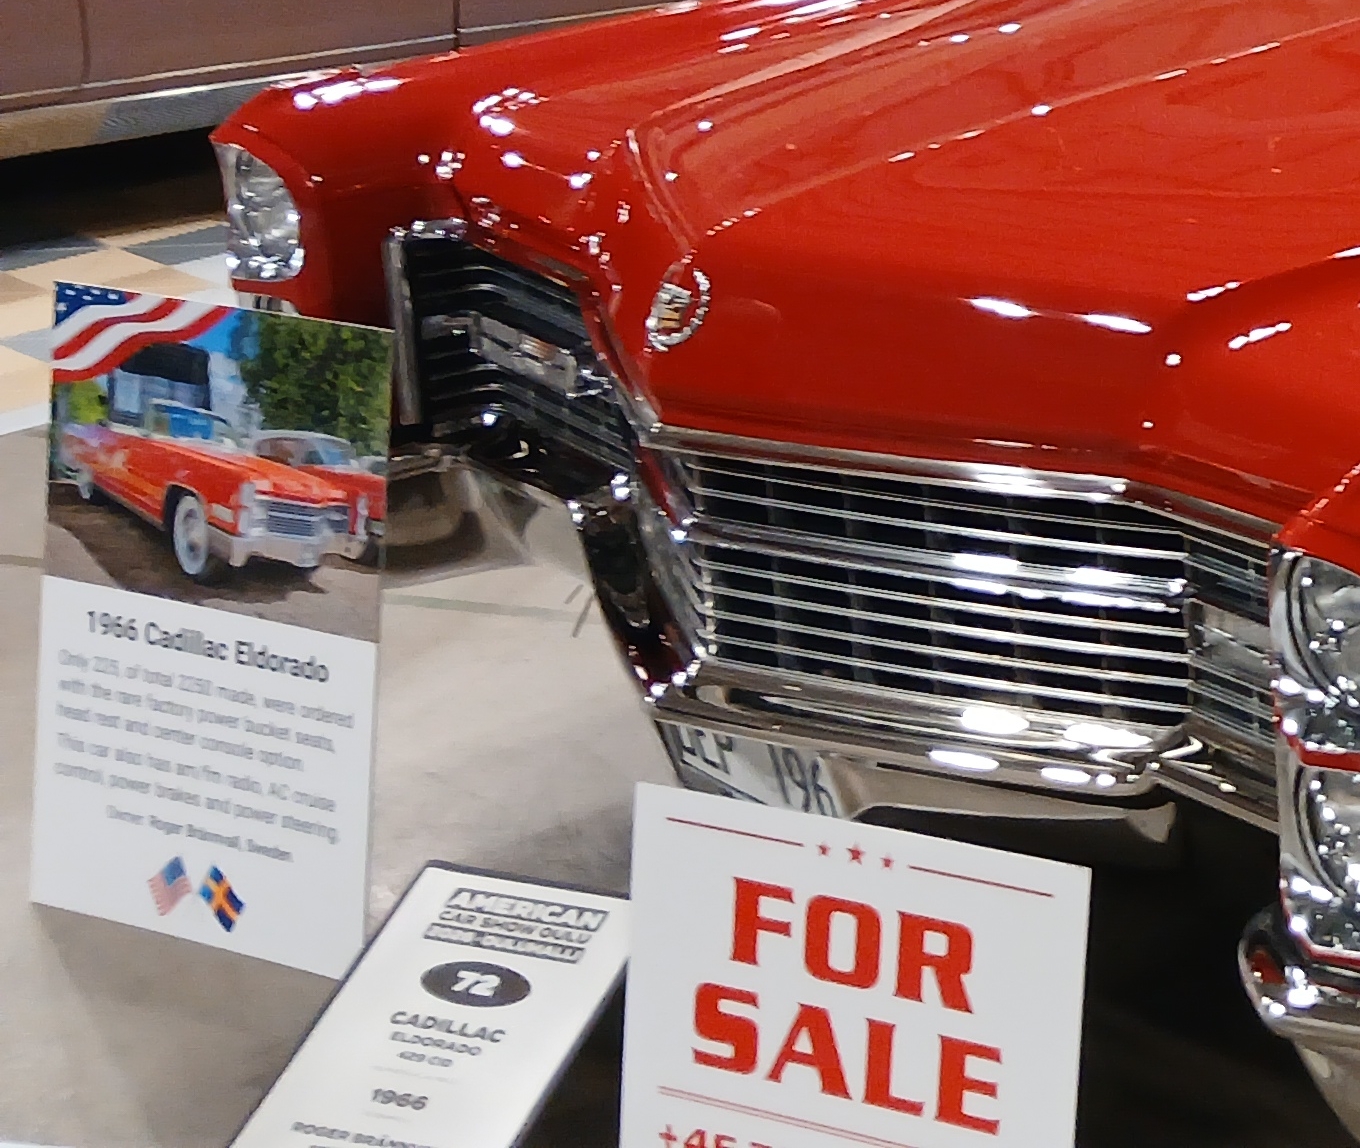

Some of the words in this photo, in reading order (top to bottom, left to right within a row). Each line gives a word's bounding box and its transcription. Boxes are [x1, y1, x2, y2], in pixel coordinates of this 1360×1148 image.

[87, 610, 139, 641] 1966
[144, 621, 229, 661] Cadillac
[235, 640, 330, 683] Eldorado
[439, 910, 477, 926] CAR
[480, 917, 537, 936] SHOW
[539, 925, 593, 944] OULU
[448, 891, 606, 931] AMERICAN
[729, 876, 974, 1014] FOR
[451, 969, 500, 997] 72
[389, 1010, 507, 1043] CADILLAC
[389, 1031, 482, 1056] ELDORADO
[691, 982, 1003, 1136] SALE
[371, 1088, 429, 1111] 1966
